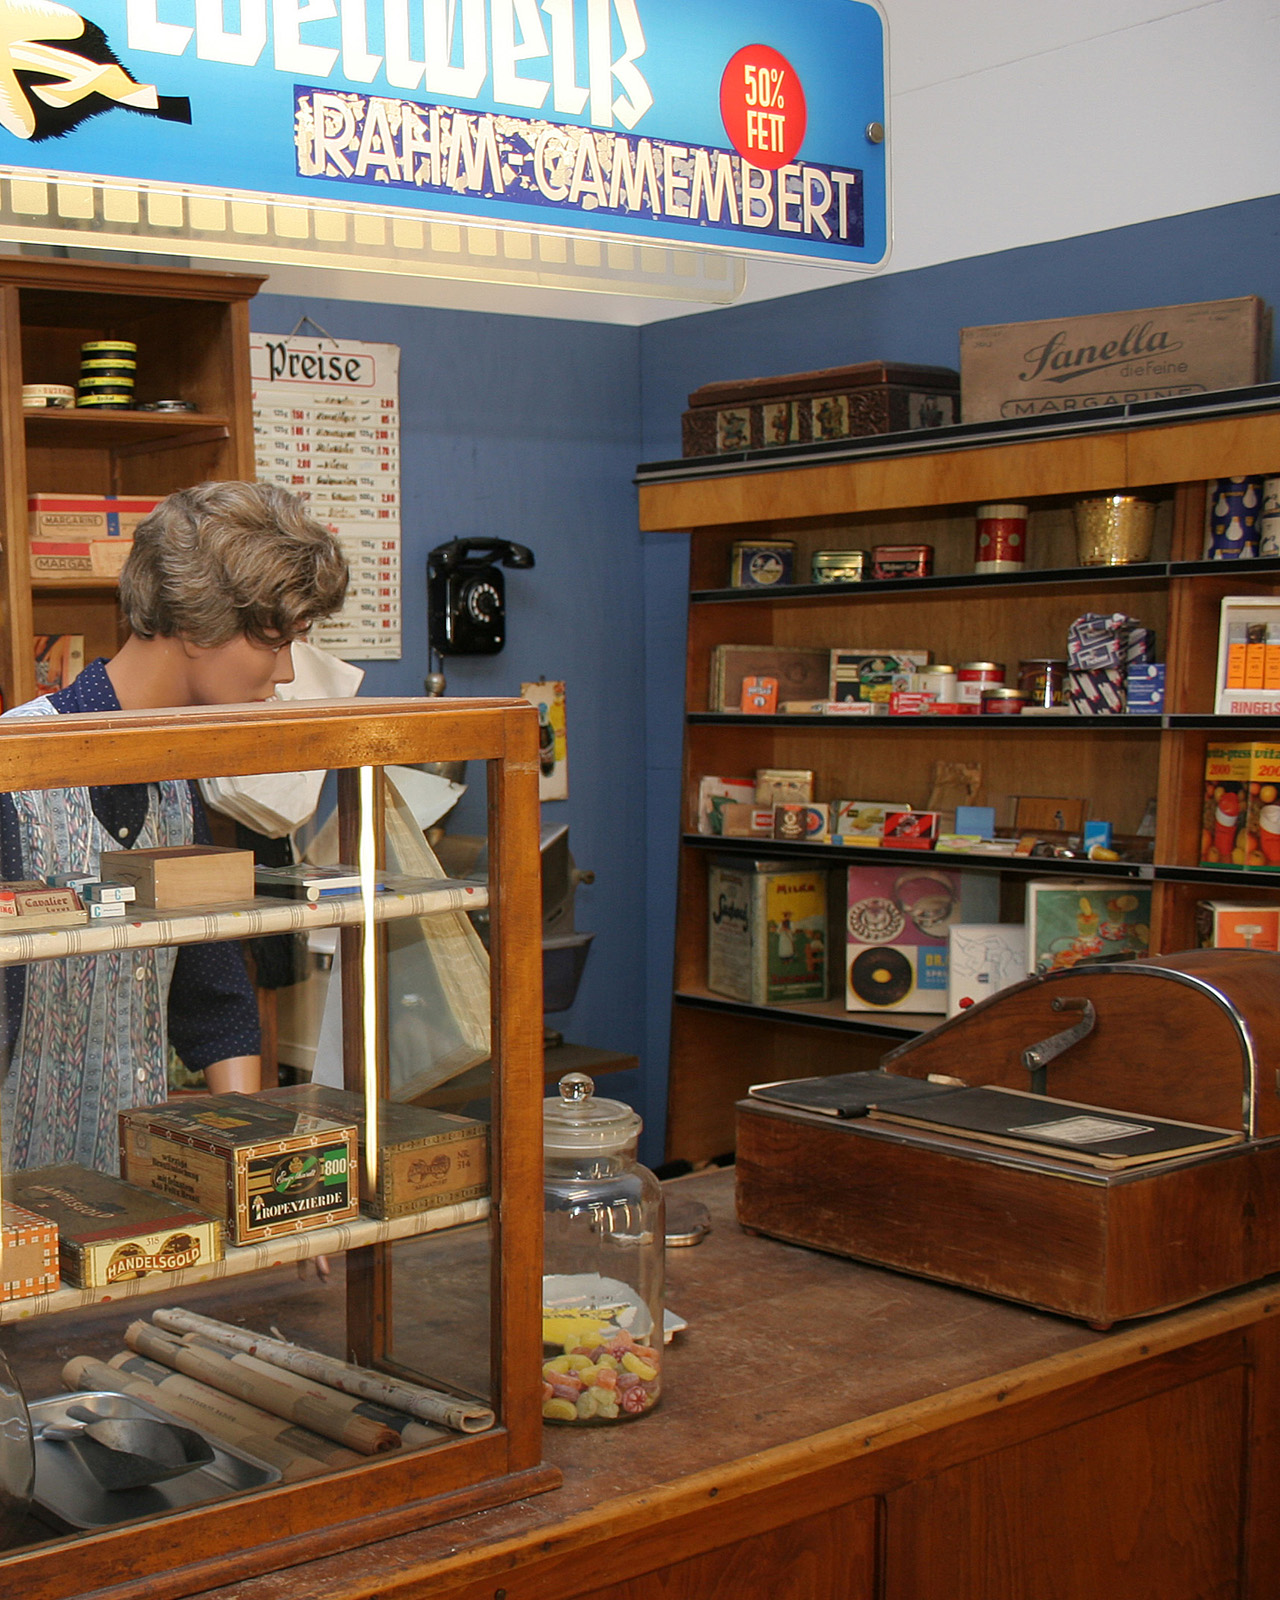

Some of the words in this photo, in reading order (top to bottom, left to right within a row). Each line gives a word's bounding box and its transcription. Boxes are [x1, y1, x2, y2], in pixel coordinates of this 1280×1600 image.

[744, 64, 785, 109] 50%
[747, 109, 786, 153] FETT
[310, 91, 855, 239] RAHM-CAMEMBERT
[266, 342, 361, 382] Preise
[1018, 321, 1183, 383] Sanella
[45, 515, 98, 525] MARGARINE
[25, 896, 68, 908] Cavalier
[777, 884, 816, 894] MILKA
[324, 1157, 346, 1176] 800
[107, 1247, 200, 1280] HANDELSGOLD
